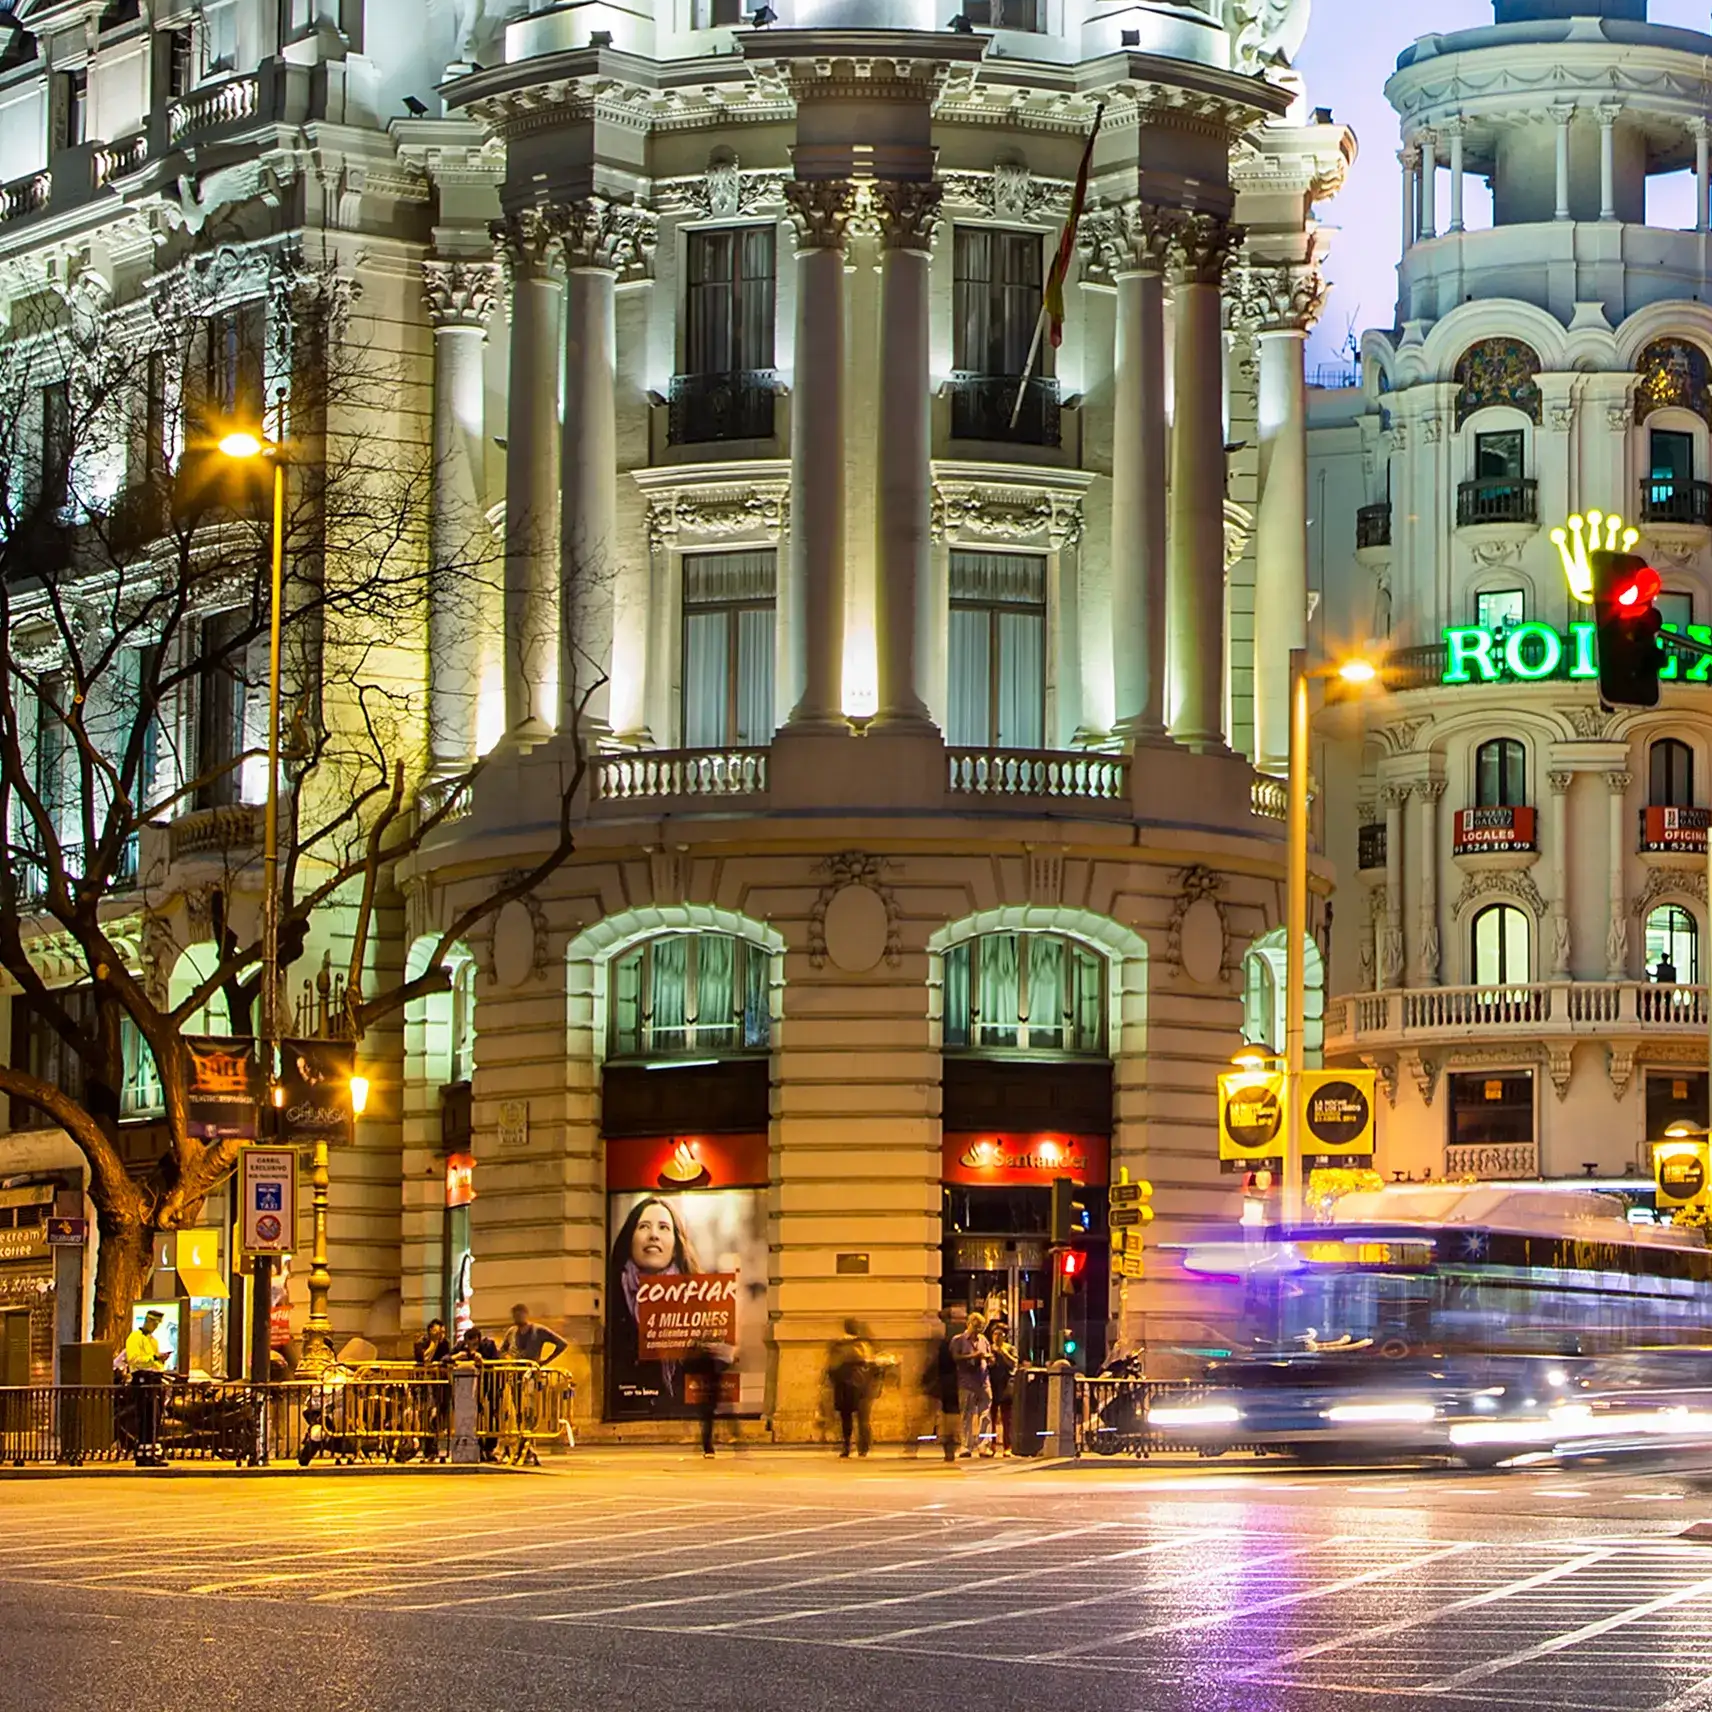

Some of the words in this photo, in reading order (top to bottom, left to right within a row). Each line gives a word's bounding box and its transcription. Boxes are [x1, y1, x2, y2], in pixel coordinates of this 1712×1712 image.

[1462, 829, 1515, 843] LOCALES
[1649, 841, 1665, 851] 91
[992, 1145, 1087, 1169] Santander
[636, 1280, 737, 1304] CONFIAR
[647, 1314, 656, 1327] 4
[660, 1311, 729, 1327] MILLONES
[658, 1329, 688, 1338] clientes
